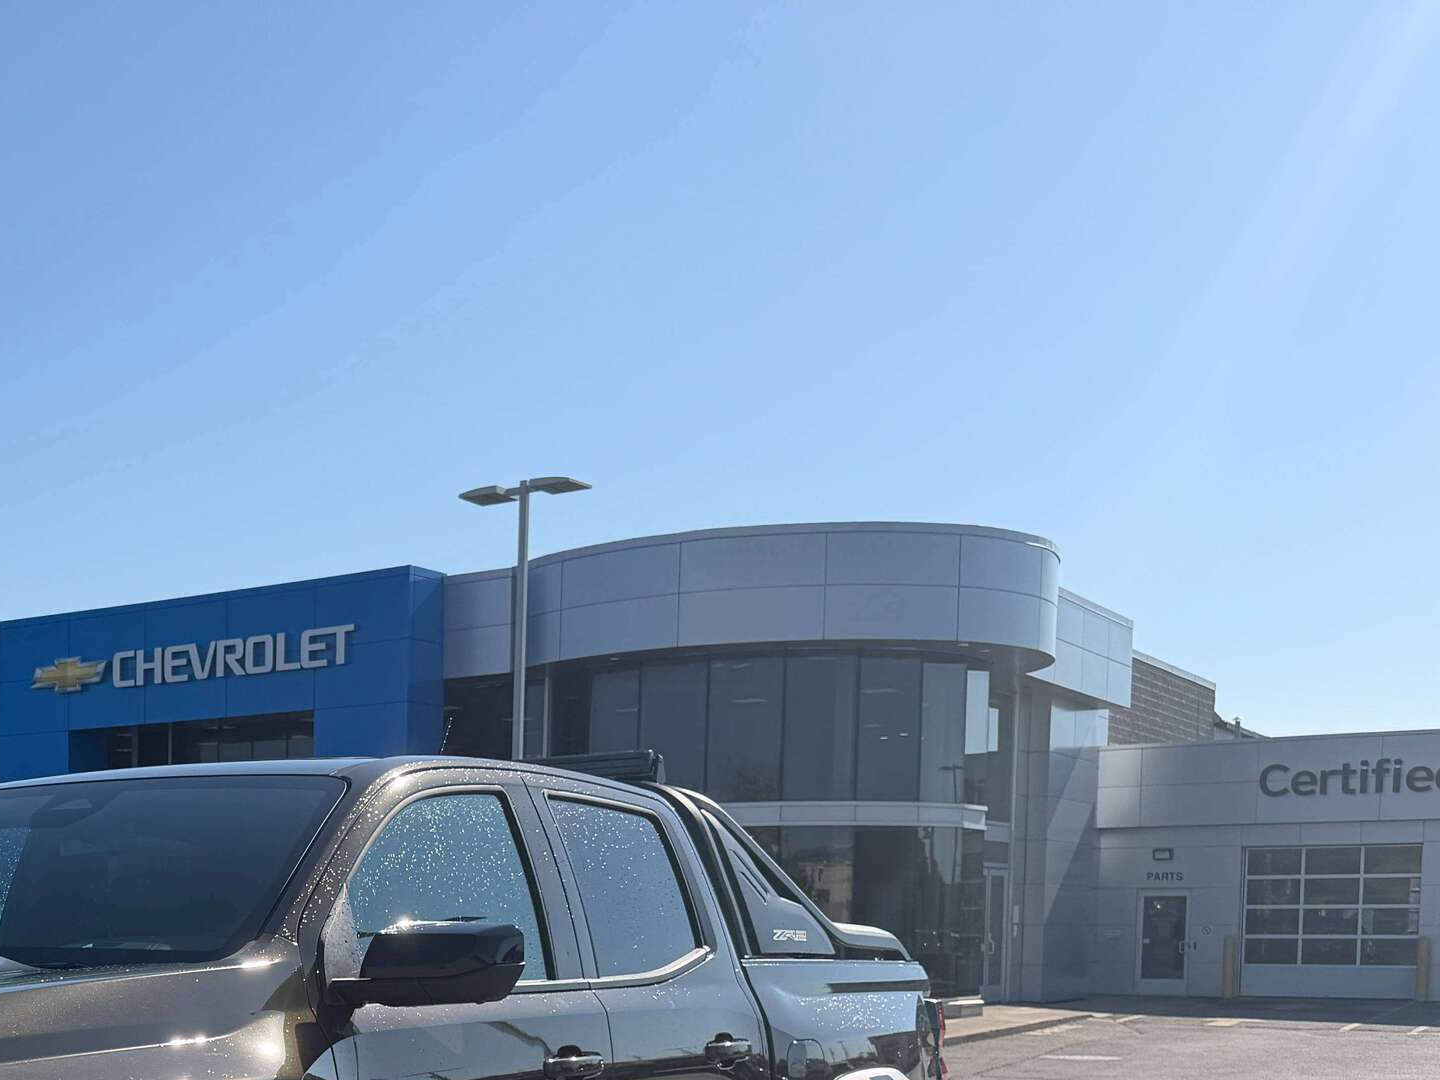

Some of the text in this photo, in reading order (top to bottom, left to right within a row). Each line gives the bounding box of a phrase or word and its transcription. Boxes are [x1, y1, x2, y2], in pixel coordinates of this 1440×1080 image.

[111, 622, 356, 689] CHEVROLET
[1259, 757, 1440, 798] Certifie
[1145, 871, 1184, 881] PARTS
